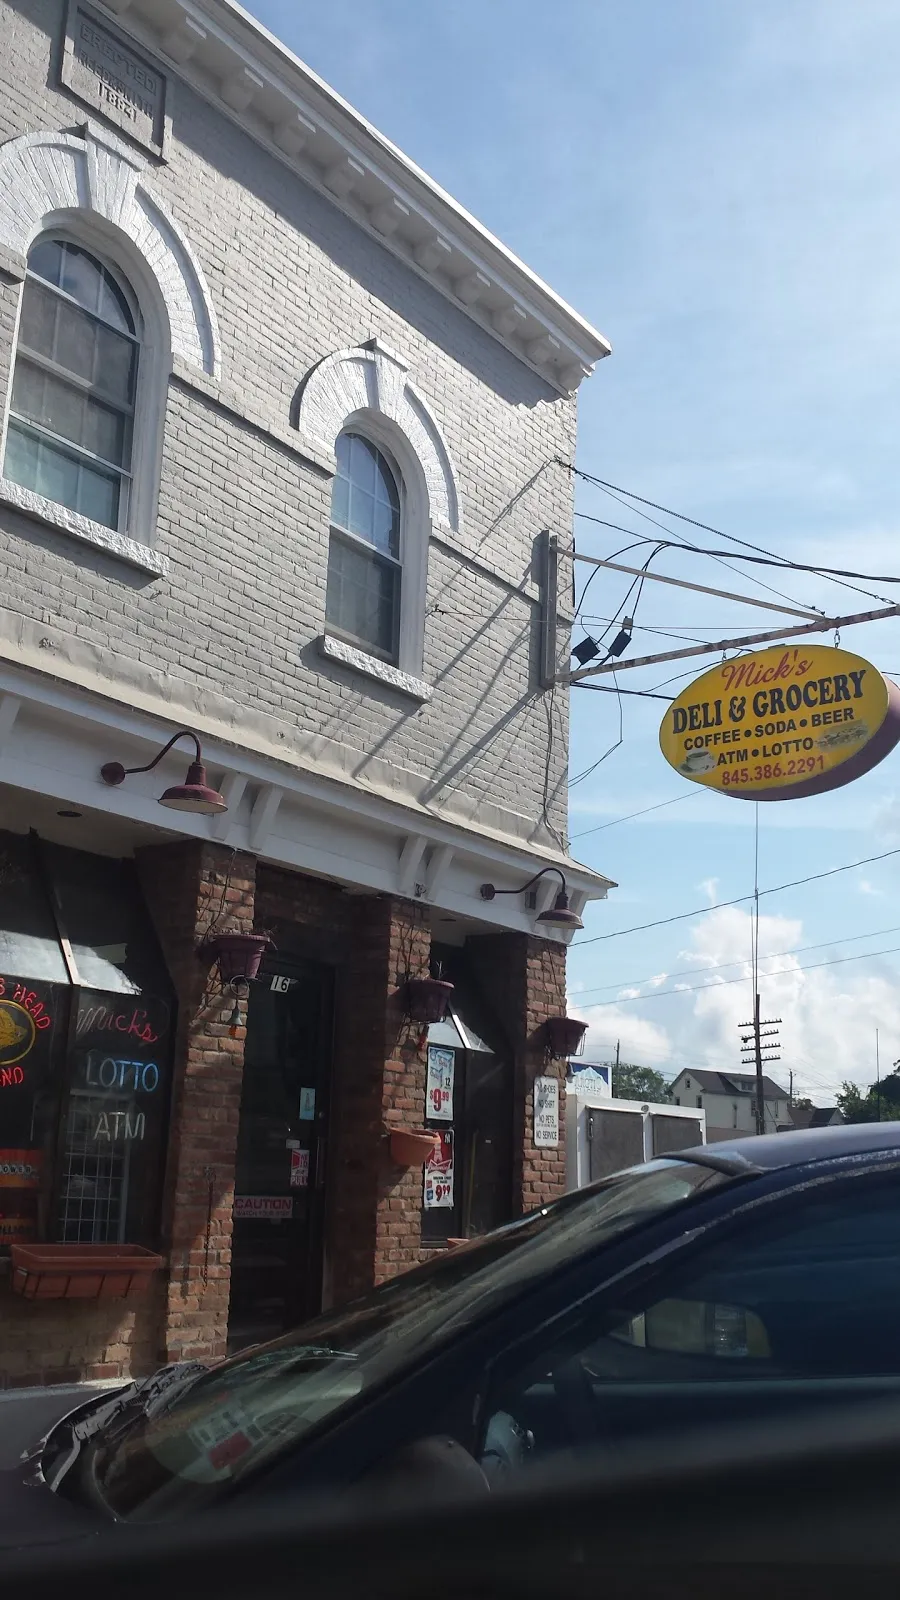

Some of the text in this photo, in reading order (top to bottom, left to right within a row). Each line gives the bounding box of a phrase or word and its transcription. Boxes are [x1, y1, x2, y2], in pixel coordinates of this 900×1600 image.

[721, 649, 813, 691] Mick's
[672, 669, 867, 734] DELI & GROCERY
[683, 707, 854, 750] COFFEE SODA BEER
[717, 737, 814, 766] ATM LOTTO
[721, 755, 824, 786] 845.386.2291
[274, 976, 288, 991] 16
[13, 984, 51, 1029] HEAD
[86, 1057, 159, 1092] LOTTO
[93, 1111, 146, 1141] ATM
[234, 1197, 292, 1210] CAUTION
